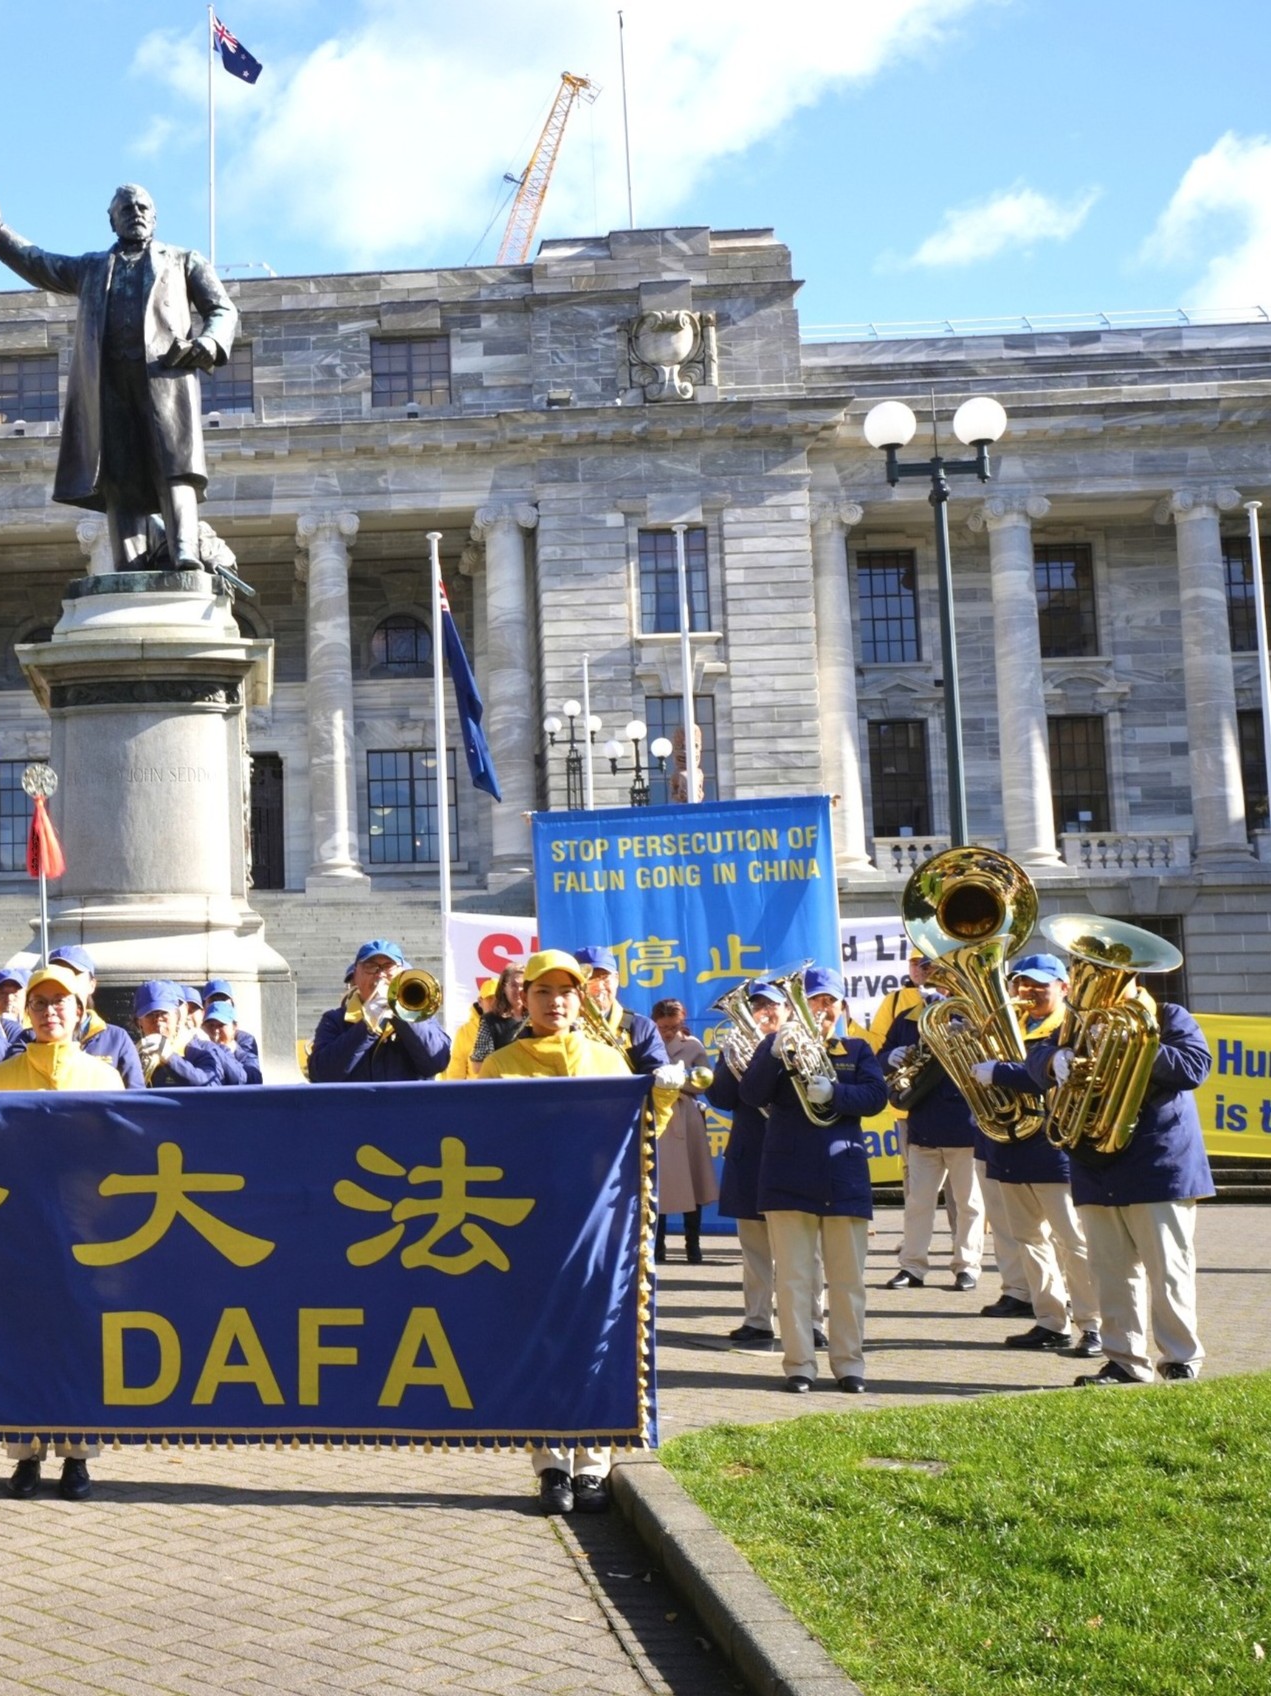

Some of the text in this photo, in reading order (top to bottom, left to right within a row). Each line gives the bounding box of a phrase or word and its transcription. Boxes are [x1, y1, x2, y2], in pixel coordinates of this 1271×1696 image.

[127, 767, 163, 783] JOHN
[551, 826, 818, 862] STOP PERSECUTION OF
[553, 858, 821, 893] FALUN GONG IN CHINA
[608, 934, 769, 988] 停止
[1218, 1039, 1271, 1078] Hu
[1215, 1094, 1248, 1132] is
[101, 1306, 474, 1410] DAFA
